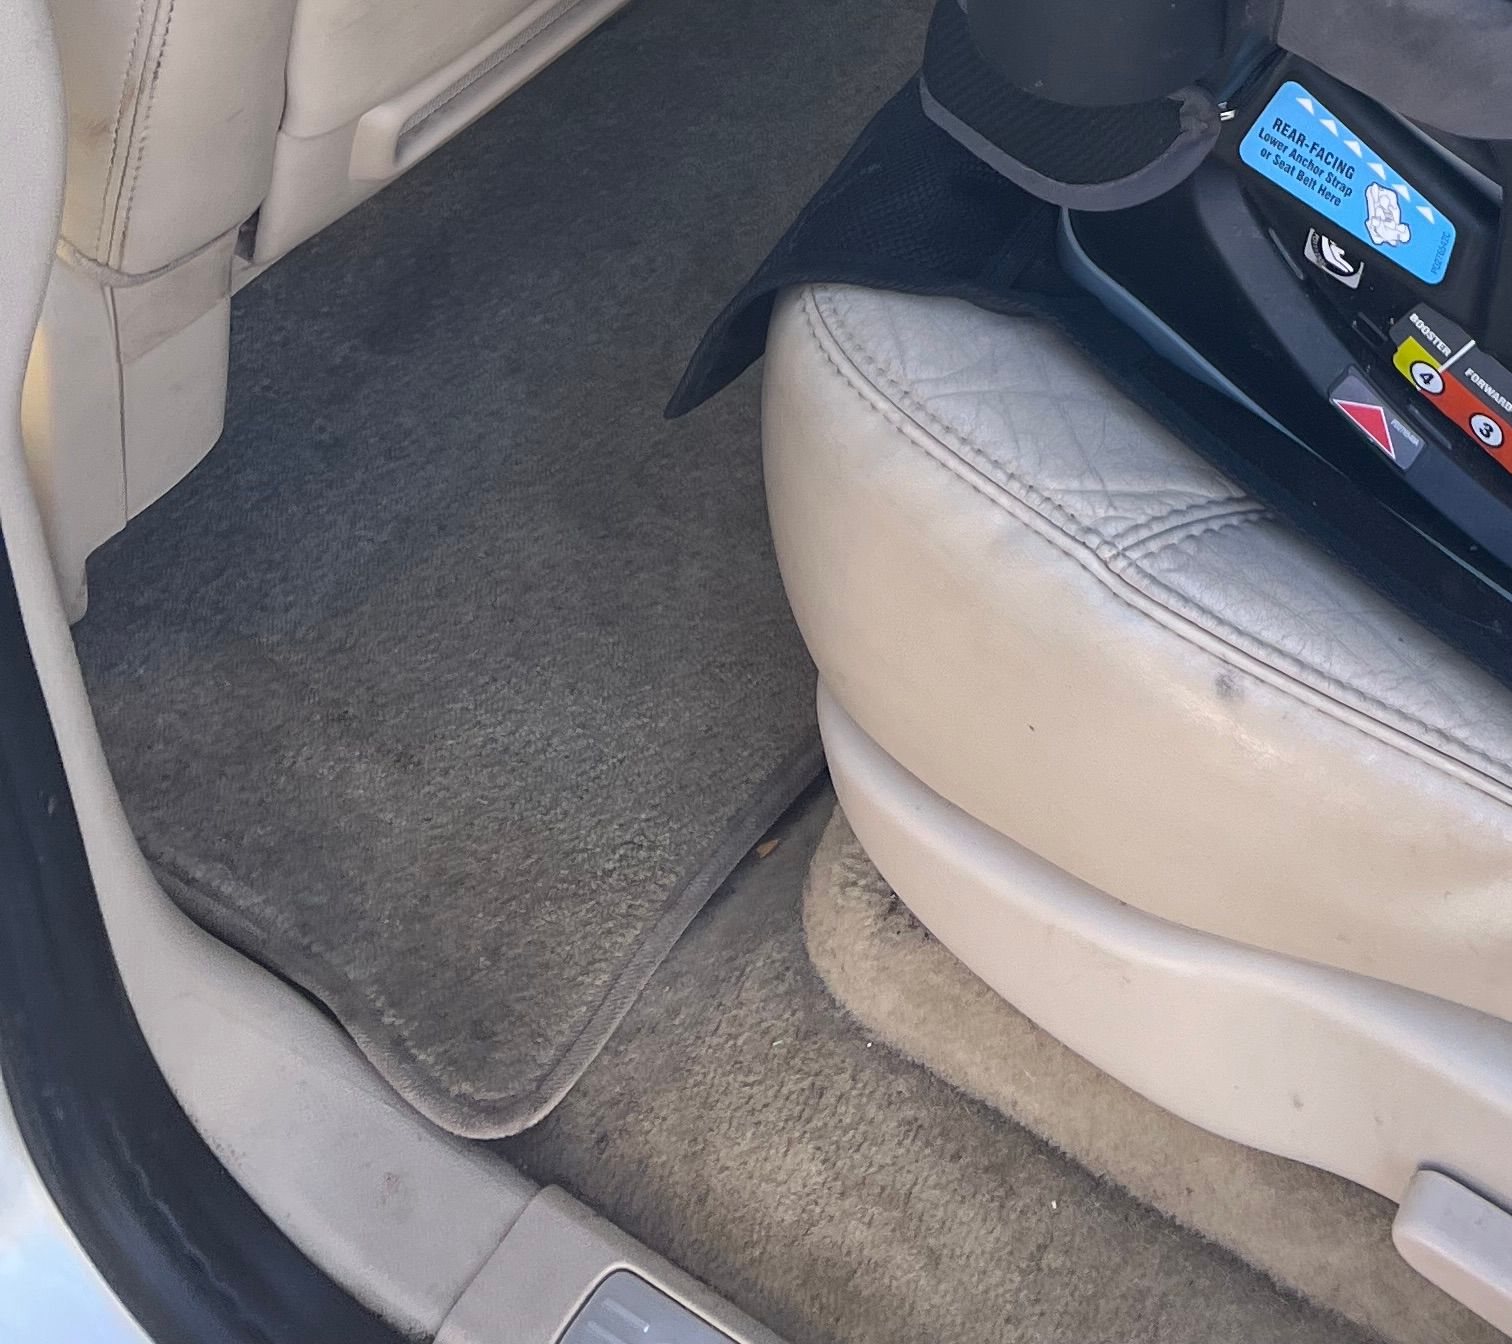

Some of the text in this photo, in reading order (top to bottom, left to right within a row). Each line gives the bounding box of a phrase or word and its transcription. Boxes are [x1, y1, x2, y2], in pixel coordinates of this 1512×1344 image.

[1259, 127, 1353, 198] Lower Anchor Strap
[1273, 118, 1355, 179] REAR-FACING
[1260, 148, 1342, 207] or Seat Belt Here
[1409, 313, 1452, 358] BOOSTER
[1419, 372, 1434, 385] 4
[1479, 423, 1494, 439] 3
